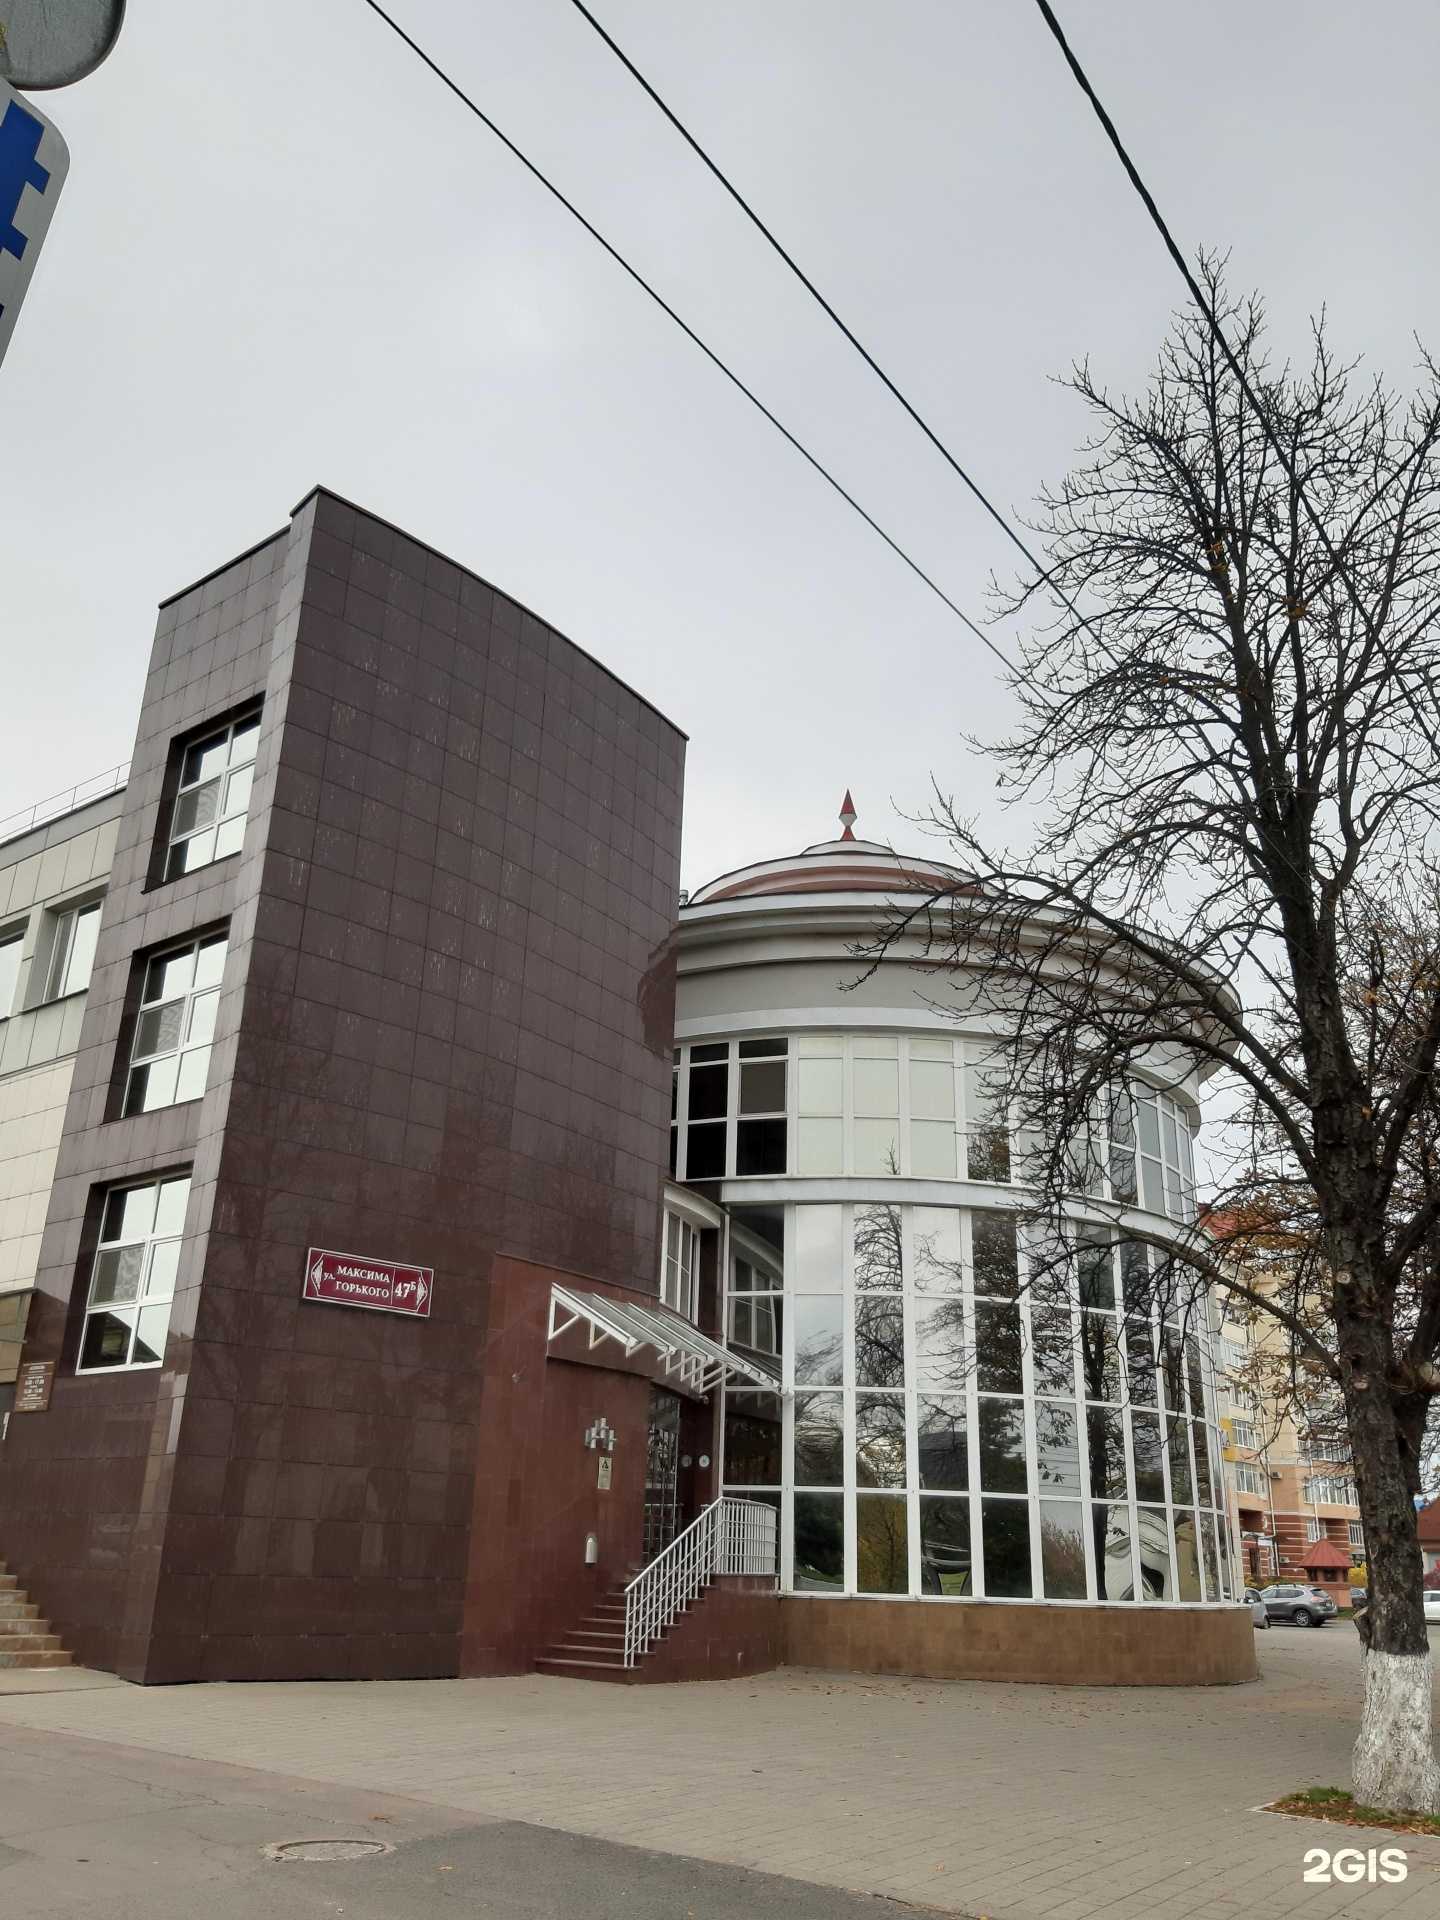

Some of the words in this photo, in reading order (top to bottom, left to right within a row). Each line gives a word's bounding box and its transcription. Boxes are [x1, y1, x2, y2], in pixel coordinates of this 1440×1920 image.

[324, 1272, 336, 1281] ул.
[337, 1265, 390, 1283] МАКСИМА
[335, 1281, 389, 1298] ГОРЬКОГО
